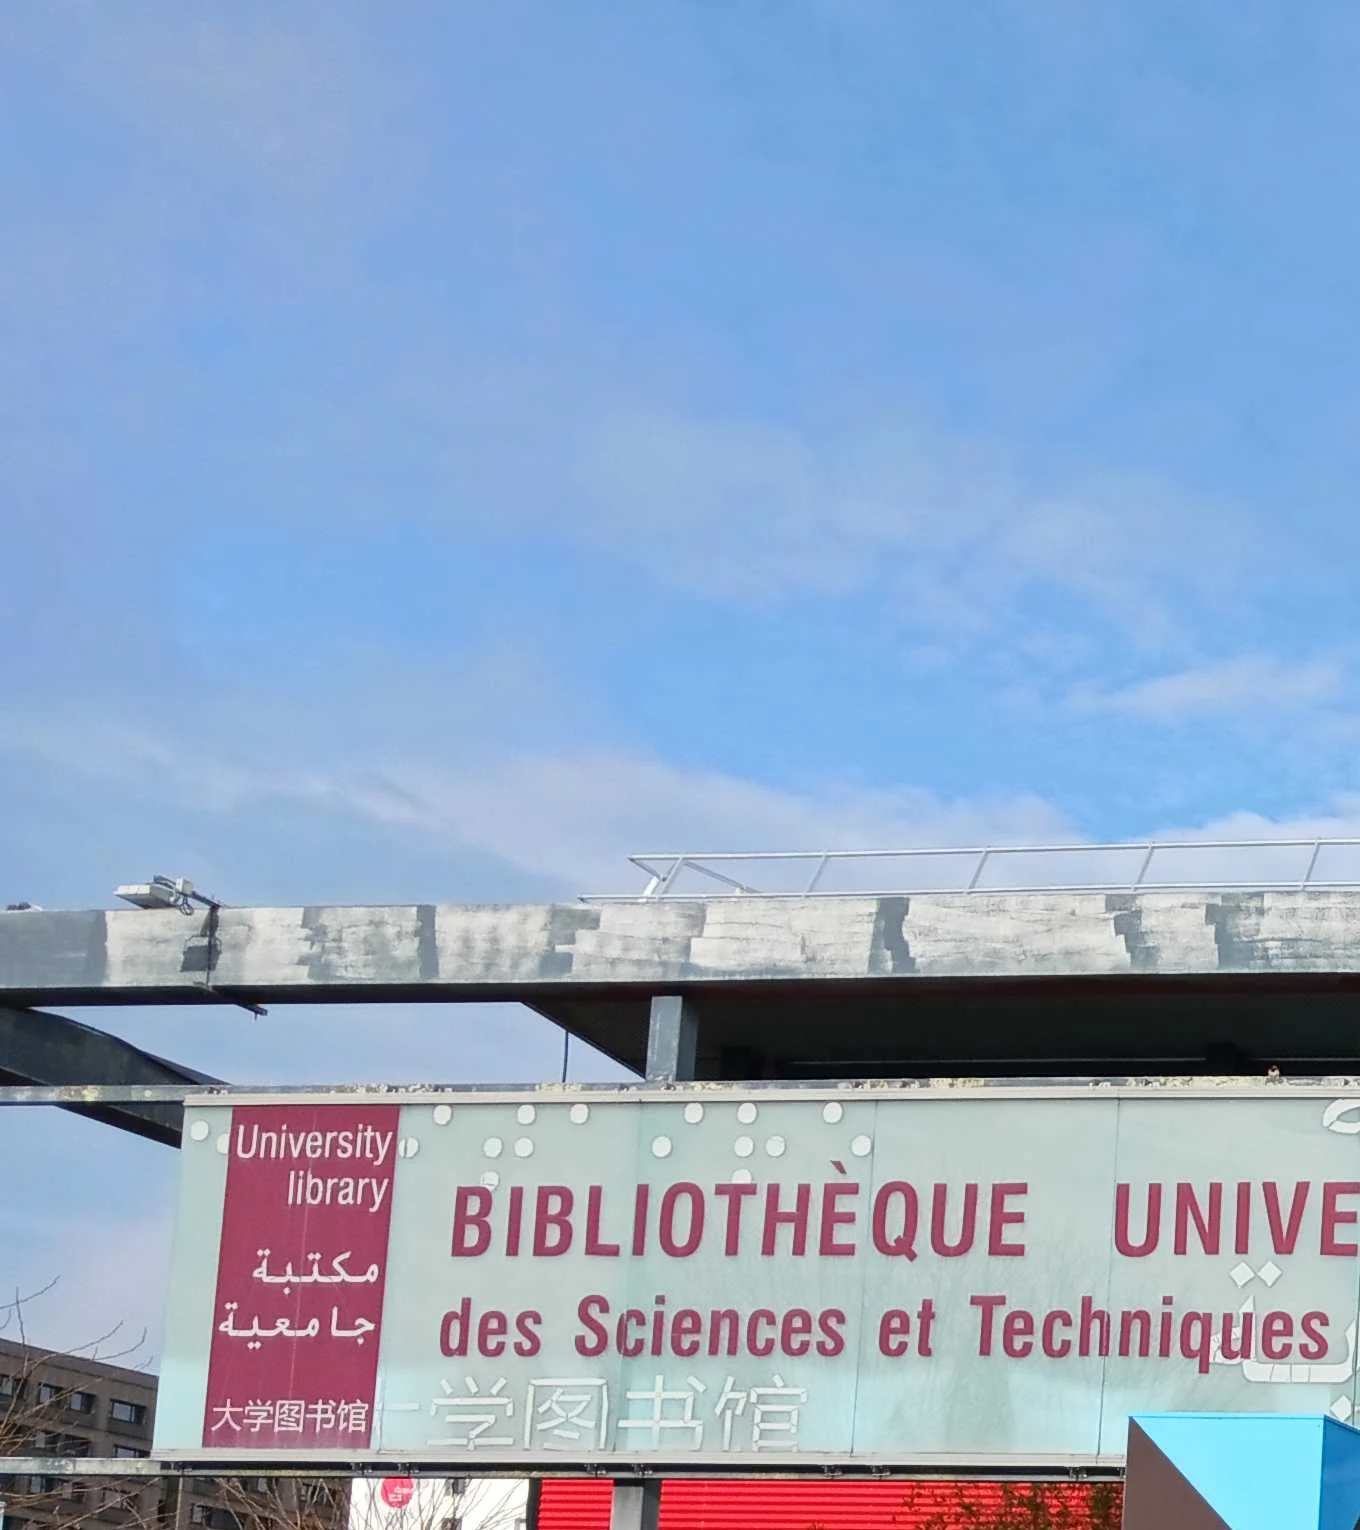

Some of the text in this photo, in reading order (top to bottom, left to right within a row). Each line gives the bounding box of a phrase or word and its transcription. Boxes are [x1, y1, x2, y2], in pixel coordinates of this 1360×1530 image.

[236, 1123, 393, 1166] University
[286, 1170, 389, 1213] library
[451, 1160, 1029, 1262] BIBLIOTHÈQUE
[252, 1248, 379, 1295] مكتبة
[440, 1294, 1330, 1374] des Sciences et Techniques
[211, 1397, 369, 1433] 大学图书馆
[376, 1373, 808, 1451] 学图书馆
